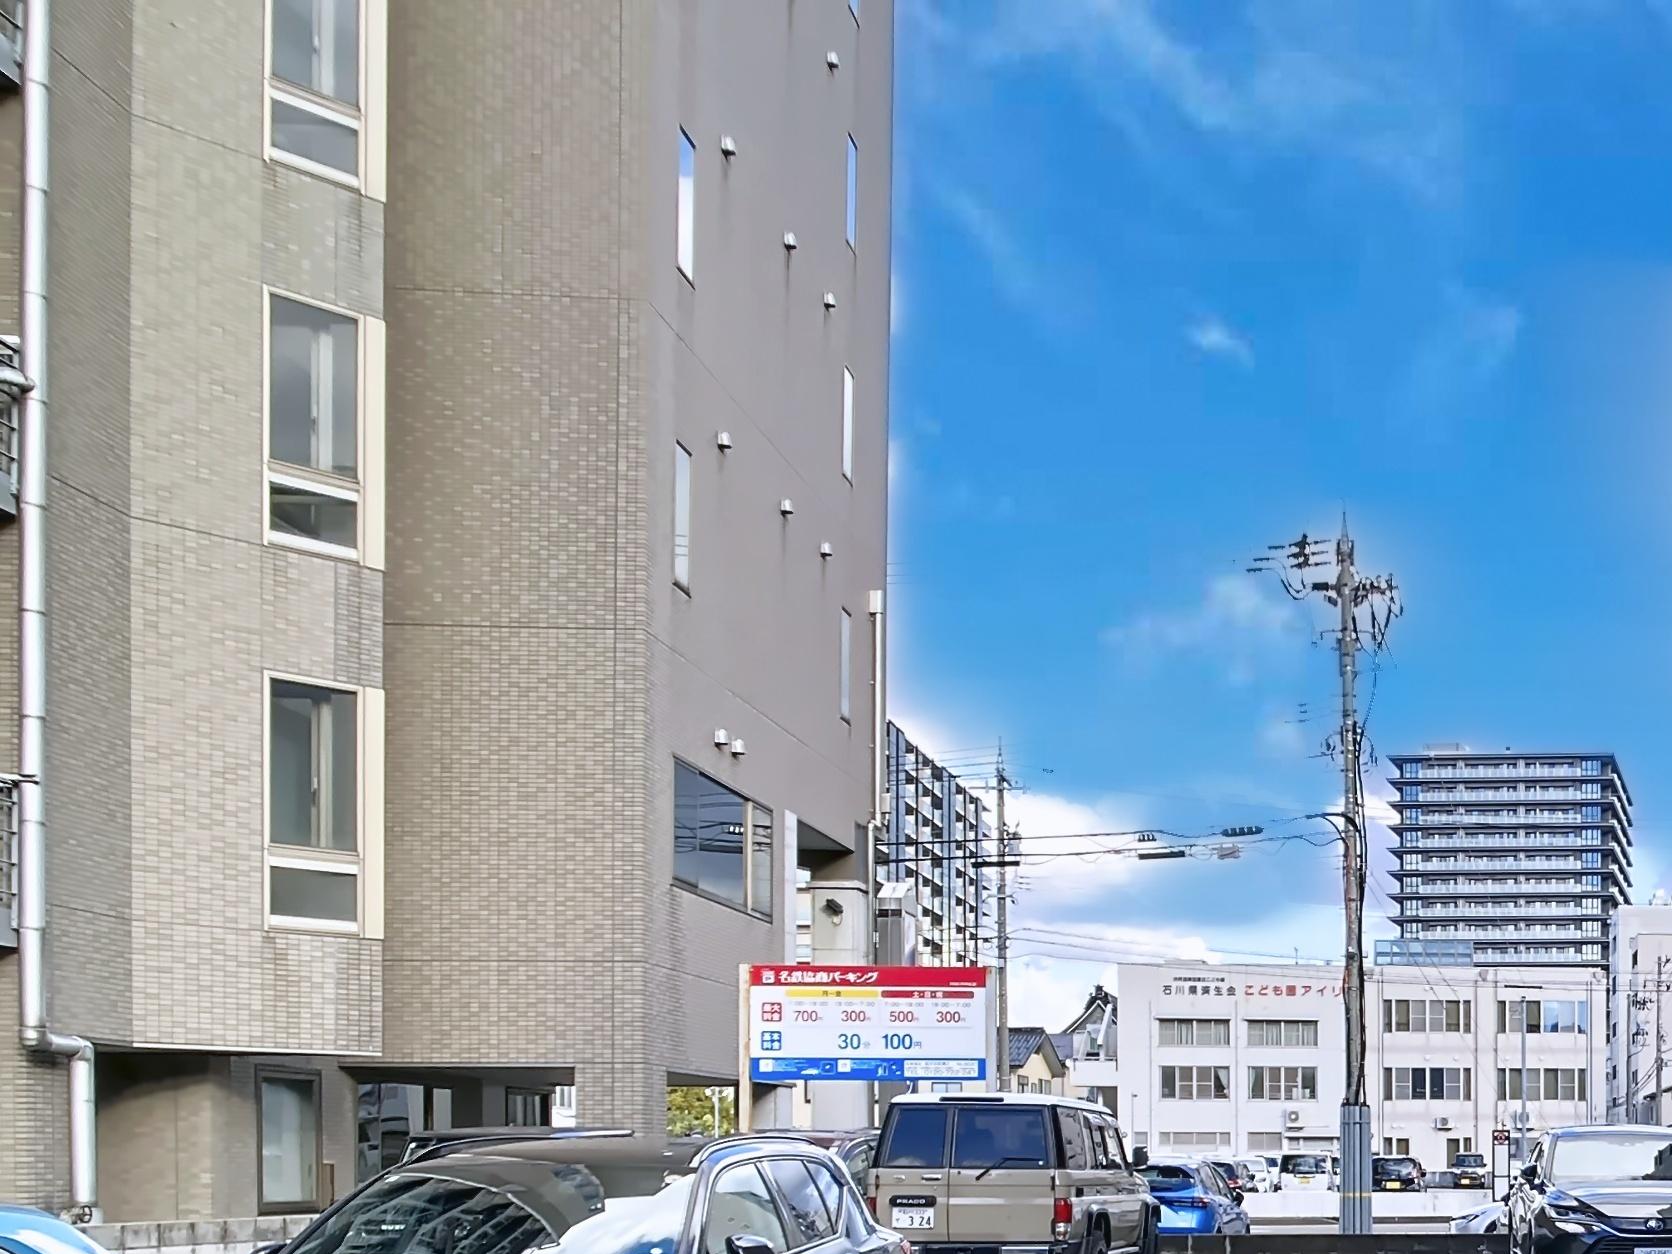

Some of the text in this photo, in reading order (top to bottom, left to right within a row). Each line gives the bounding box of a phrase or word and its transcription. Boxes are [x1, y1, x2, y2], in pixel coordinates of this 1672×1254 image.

[1162, 984, 1236, 996] 石川県済生会
